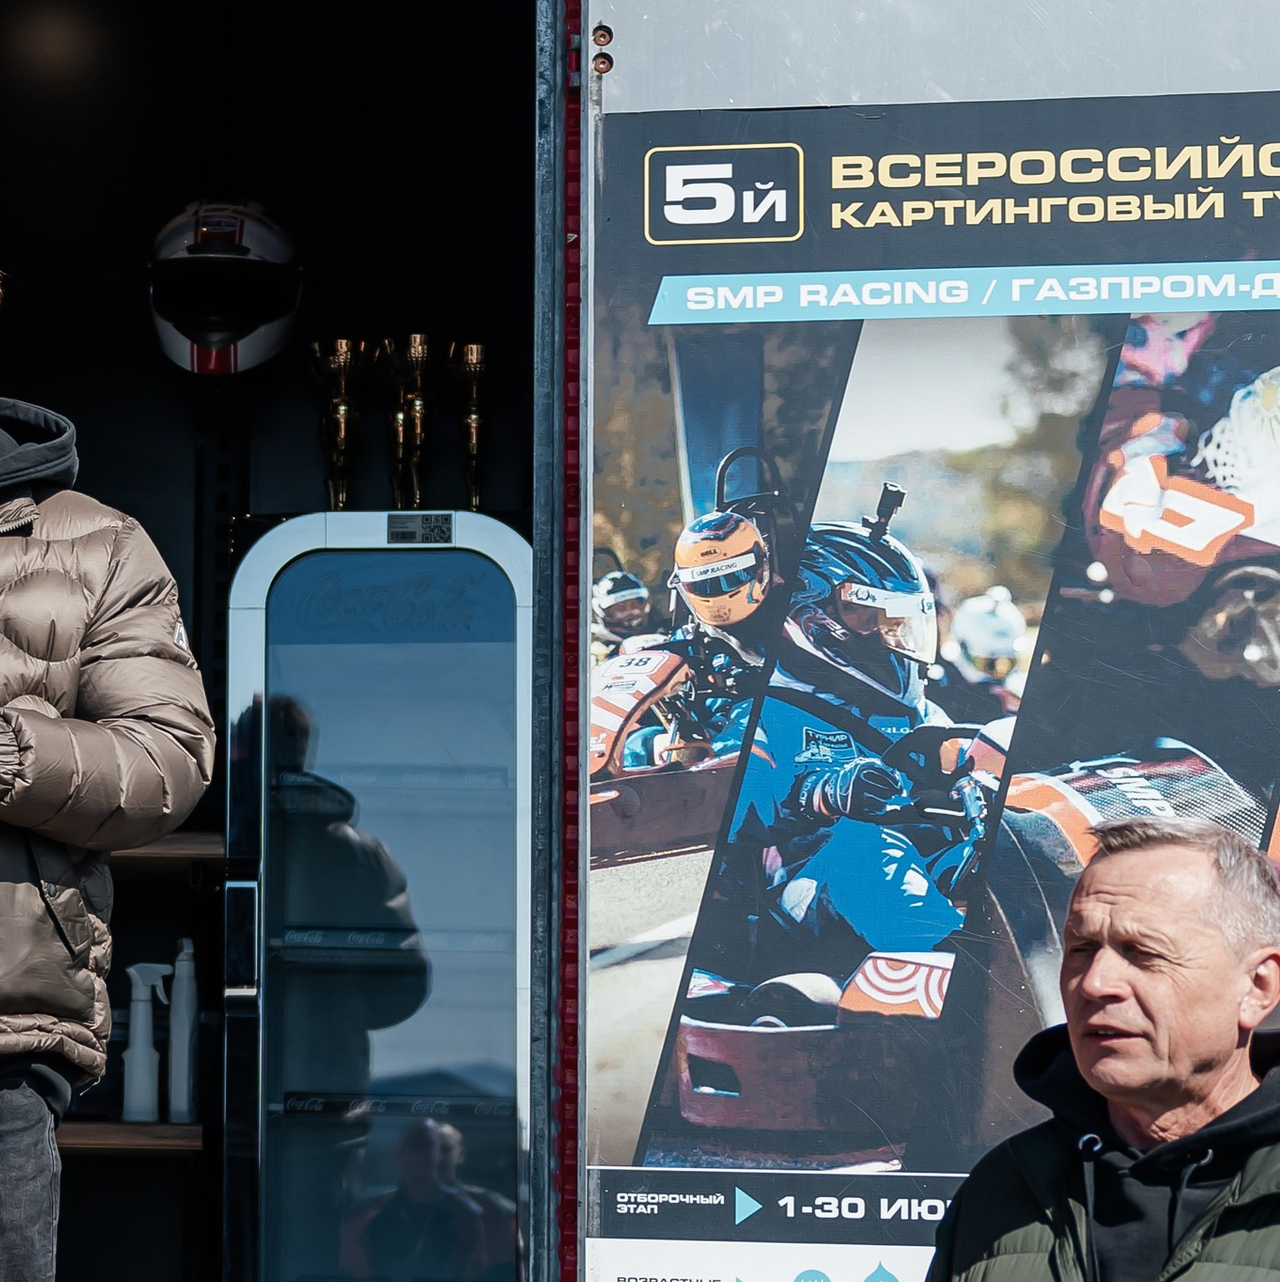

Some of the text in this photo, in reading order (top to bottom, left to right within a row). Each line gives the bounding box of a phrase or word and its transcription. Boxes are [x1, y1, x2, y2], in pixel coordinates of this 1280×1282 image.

[831, 186, 1280, 229] КАРТИНГОВЫЙ Т
[685, 287, 784, 310] SMP
[800, 280, 968, 307] RACING
[711, 562, 738, 574] RACING
[618, 657, 652, 668] 38
[617, 1192, 725, 1205] ОТБОРОЧНЫЙ
[617, 1204, 658, 1214] ЭТАП
[778, 1196, 952, 1221] 1-30 ИЮ
